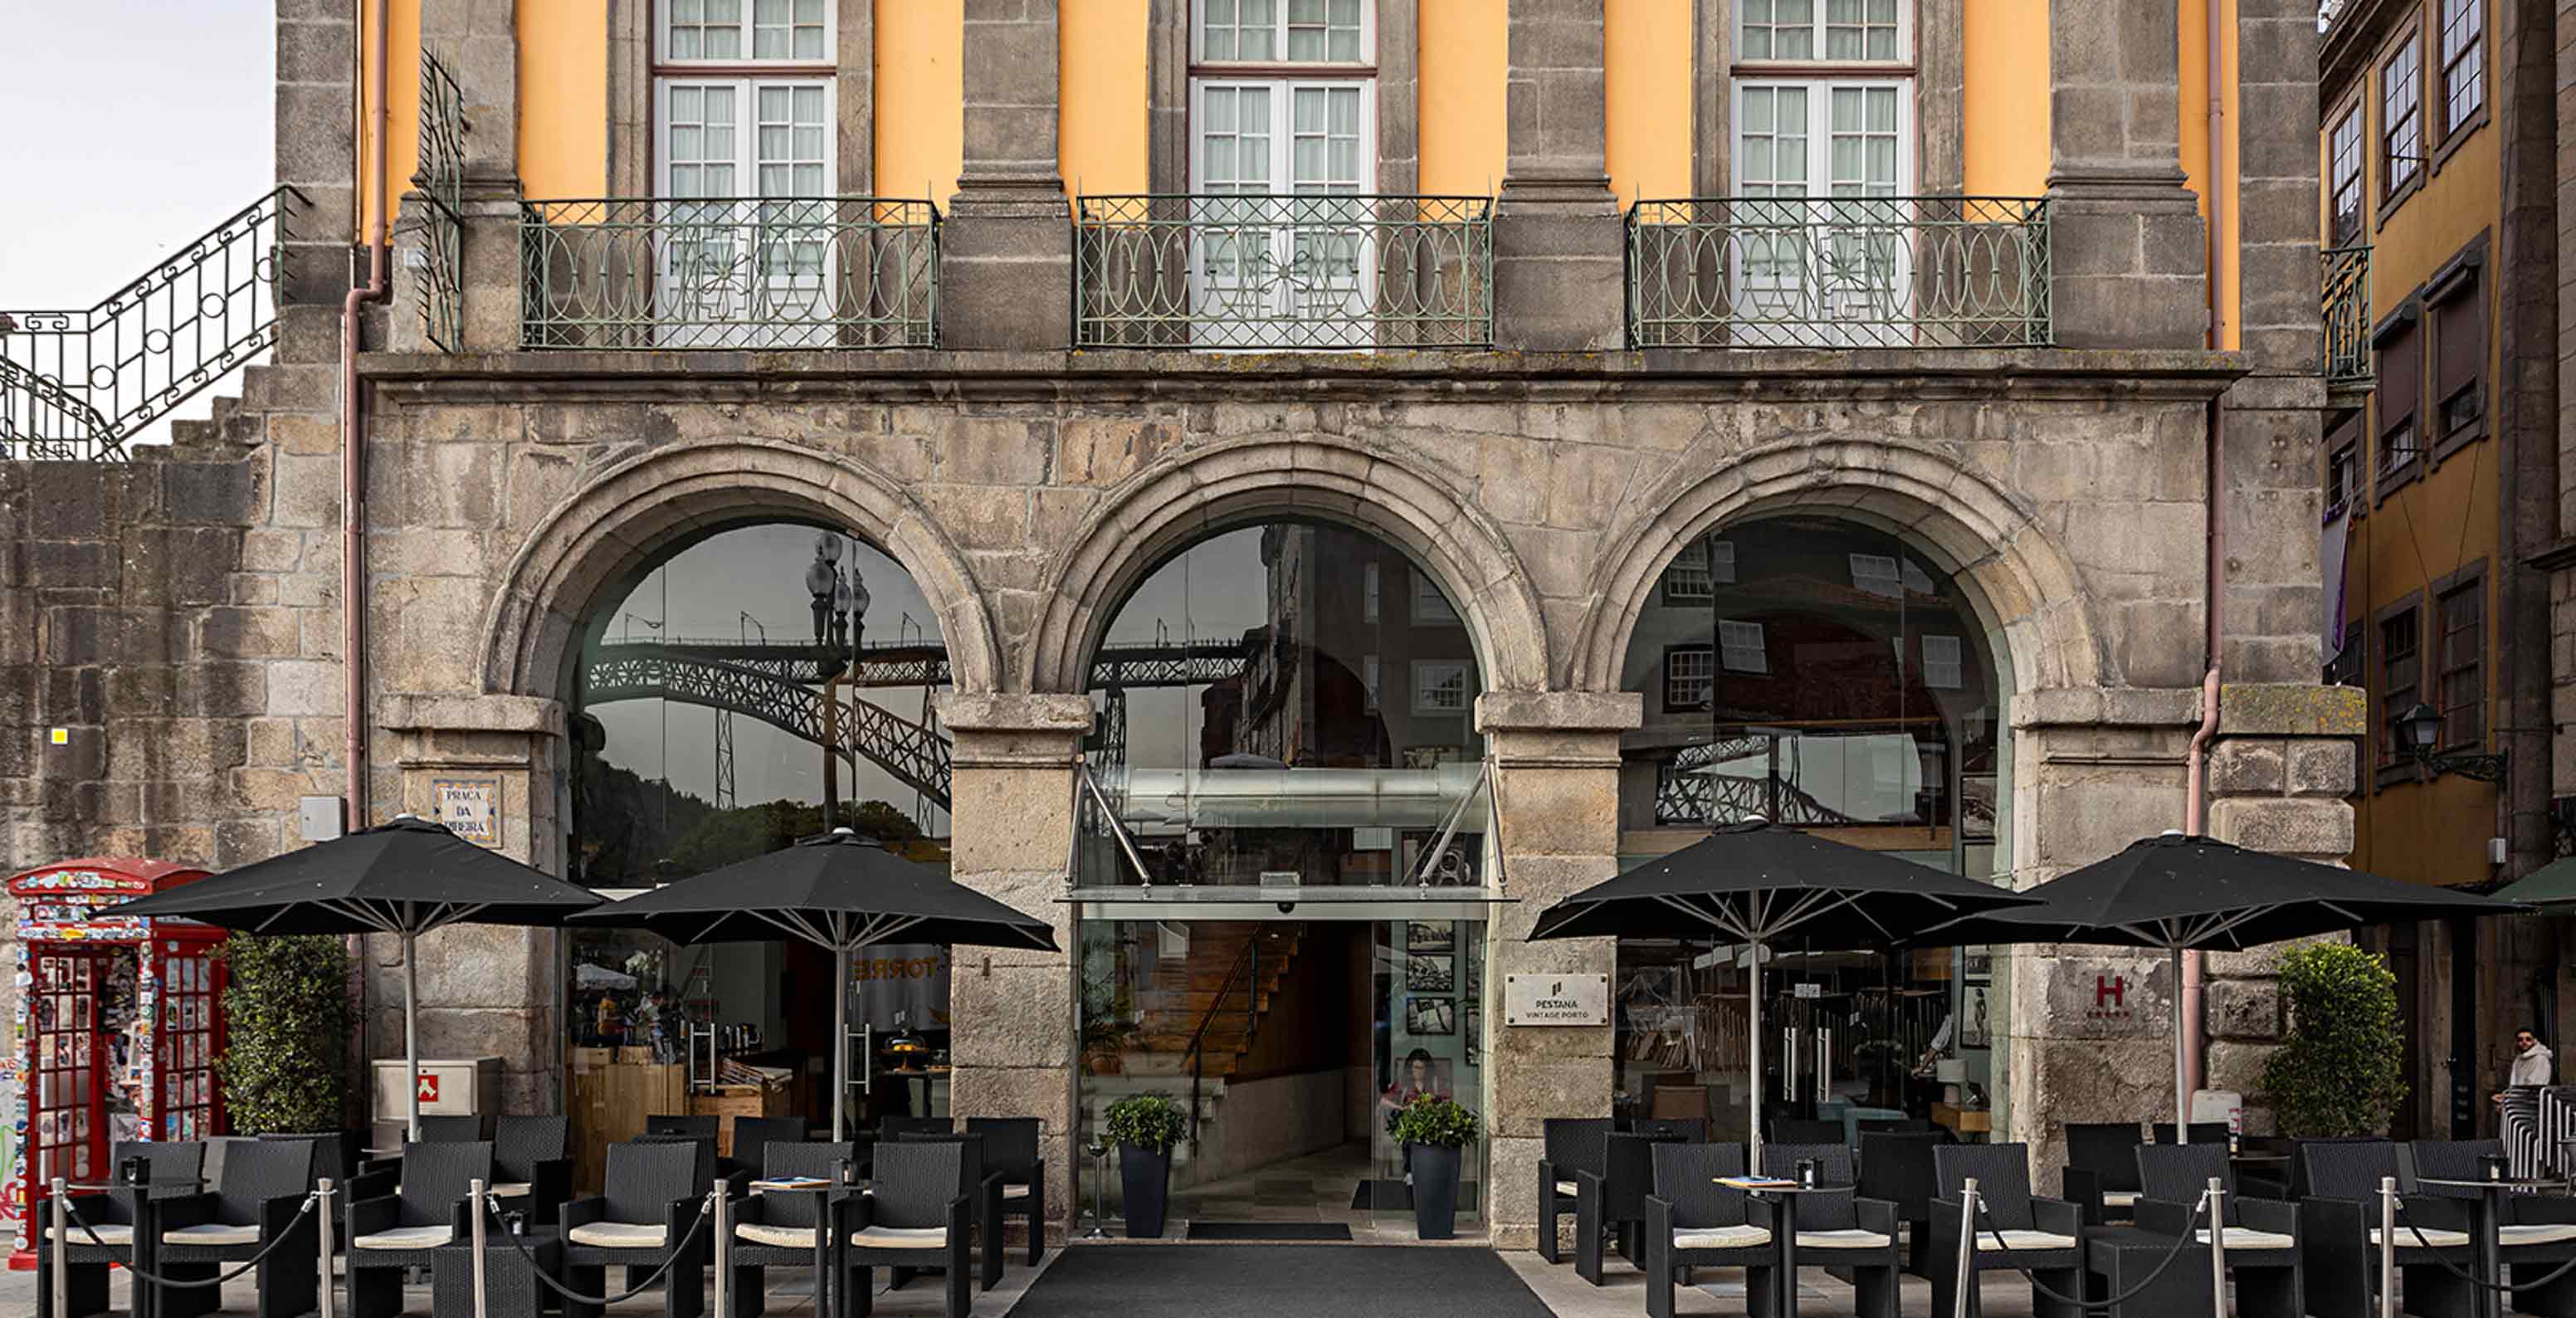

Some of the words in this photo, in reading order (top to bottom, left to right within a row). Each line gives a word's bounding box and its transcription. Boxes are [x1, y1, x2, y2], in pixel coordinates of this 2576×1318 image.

[456, 806, 471, 817] DA
[2096, 974, 2123, 1008] H
[1535, 1000, 1578, 1008] PESTANA
